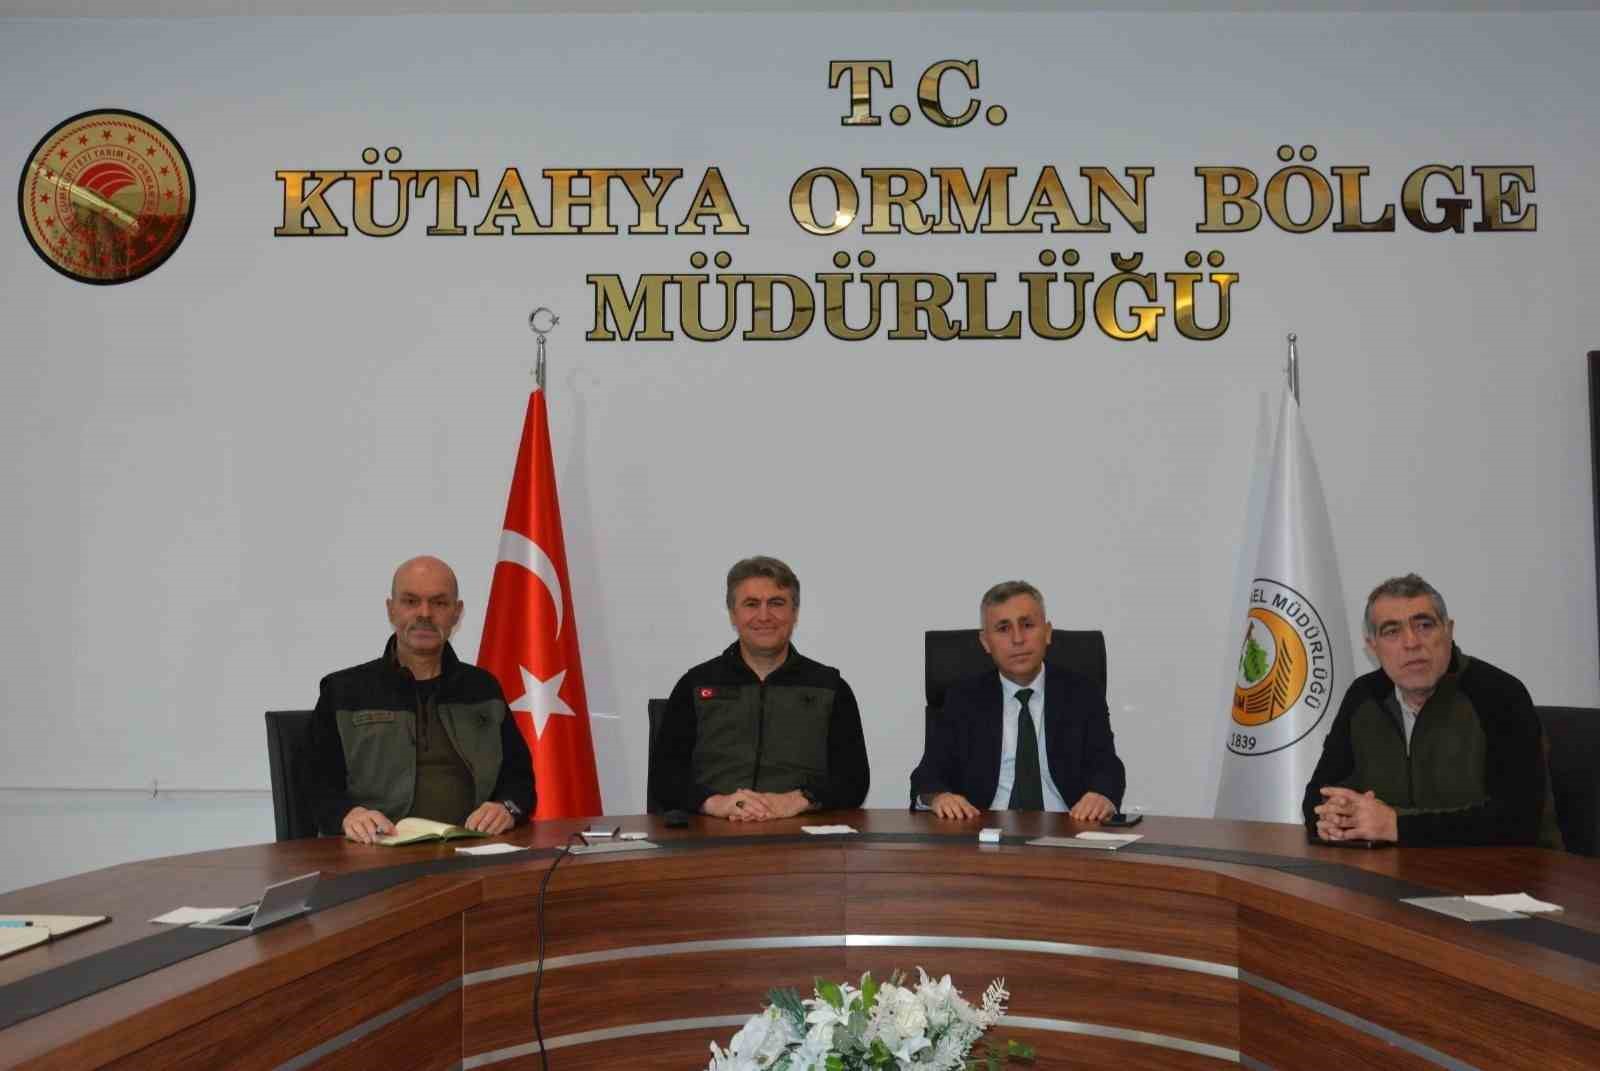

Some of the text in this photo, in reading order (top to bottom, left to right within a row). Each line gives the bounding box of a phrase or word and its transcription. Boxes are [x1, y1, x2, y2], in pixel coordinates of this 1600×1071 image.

[828, 59, 1008, 128] T.C.
[274, 144, 1538, 237] KÜTAHYA ORMAN BÖLGE
[585, 249, 1240, 342] MÜDÜRLÜĞÜ
[1250, 589, 1329, 710] EL MÜDÜRLÜĞÜ
[1231, 732, 1257, 750] 1839
